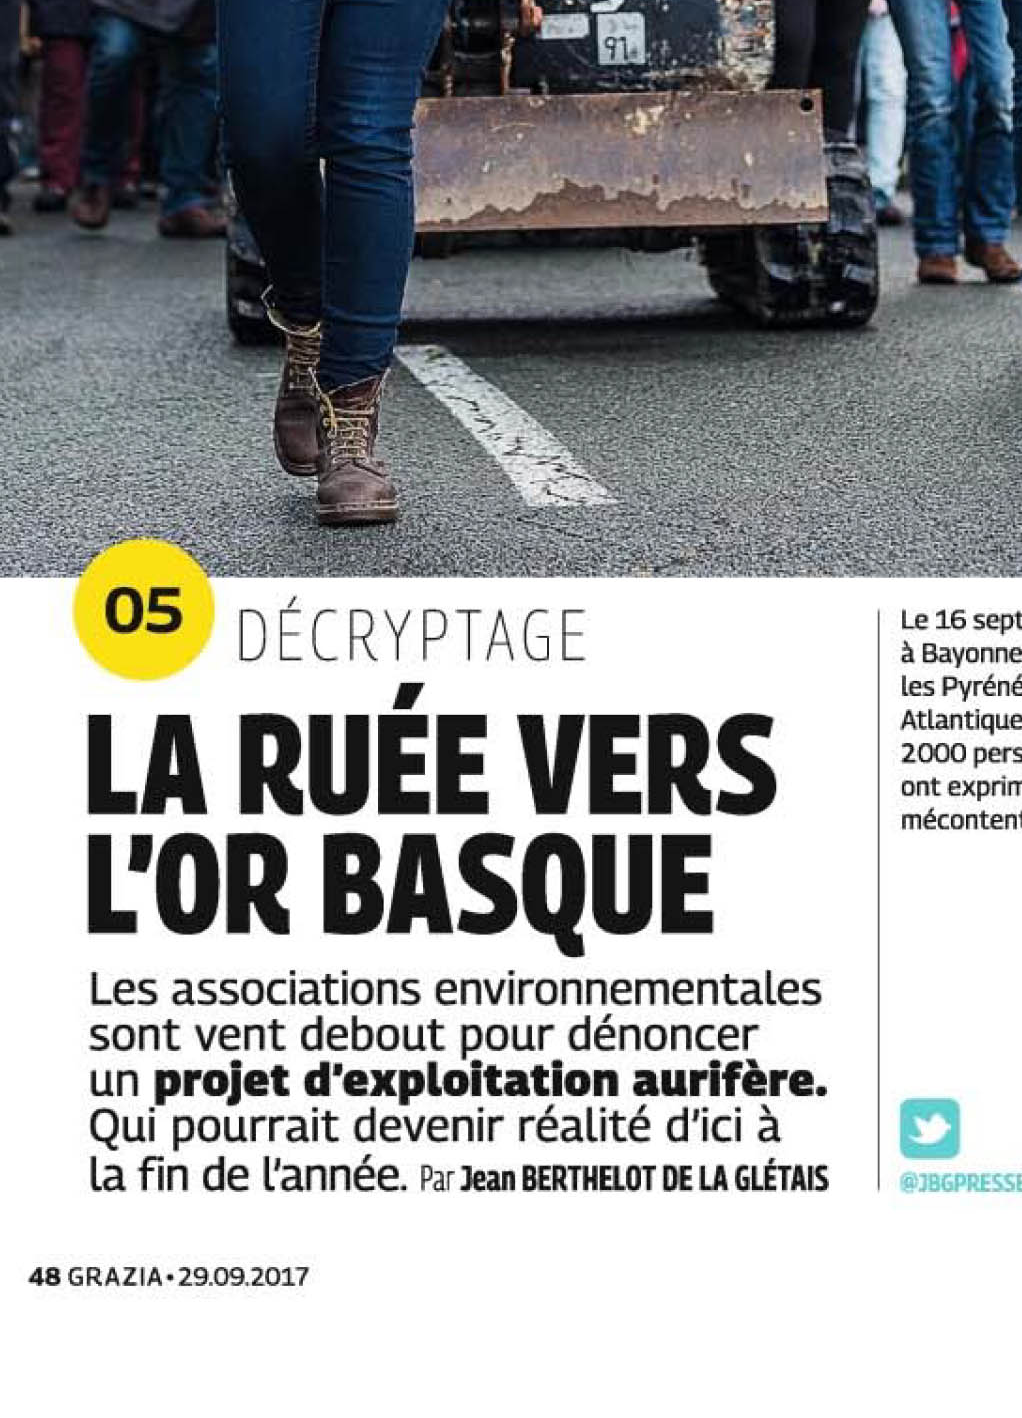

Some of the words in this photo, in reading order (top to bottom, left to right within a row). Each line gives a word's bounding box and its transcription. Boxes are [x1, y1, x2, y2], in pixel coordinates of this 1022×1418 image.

[105, 586, 183, 634] 05
[238, 595, 586, 663] DÉCRYPTAGE
[901, 609, 929, 631] Le
[935, 609, 967, 631] 16
[901, 640, 915, 663] à
[901, 675, 935, 697] les
[87, 714, 208, 815] LA
[238, 682, 490, 817] RUÉE
[516, 712, 777, 817] VERS
[901, 742, 967, 764] 2000
[901, 777, 942, 797] ont
[87, 832, 291, 936] L'OR
[322, 832, 714, 958] BASQUE
[91, 971, 158, 1007] Les
[172, 969, 422, 1007] associations
[435, 969, 822, 1007] environnementales
[89, 1018, 182, 1052] sont
[194, 1018, 287, 1052] vent
[300, 1014, 446, 1052] debout
[460, 1024, 555, 1061] pour
[567, 1013, 760, 1052] dénoncer
[90, 1069, 139, 1097] un
[154, 1059, 291, 1107] projet
[303, 1059, 619, 1107] d'exploitation
[632, 1058, 828, 1097] aurifère.
[89, 1106, 156, 1152] Qui
[172, 1106, 340, 1152] pourrait
[353, 1106, 505, 1144] devenir
[518, 1103, 651, 1144] réalité
[666, 1106, 742, 1144] d'ici
[757, 1103, 781, 1143] à
[90, 1155, 127, 1193] la
[137, 1155, 189, 1191] fin
[202, 1155, 250, 1193] de
[263, 1153, 407, 1193] l'année.
[420, 1164, 456, 1193] Par
[459, 1165, 516, 1193] Jean
[522, 1164, 657, 1193] BERTHELOT
[662, 1164, 693, 1193] DE
[699, 1164, 729, 1191] LA
[734, 1157, 830, 1193] GLÉTAIS
[28, 1266, 62, 1287] 48
[67, 1266, 163, 1287] GRAZIA
[178, 1266, 309, 1287] 29.09.2017
